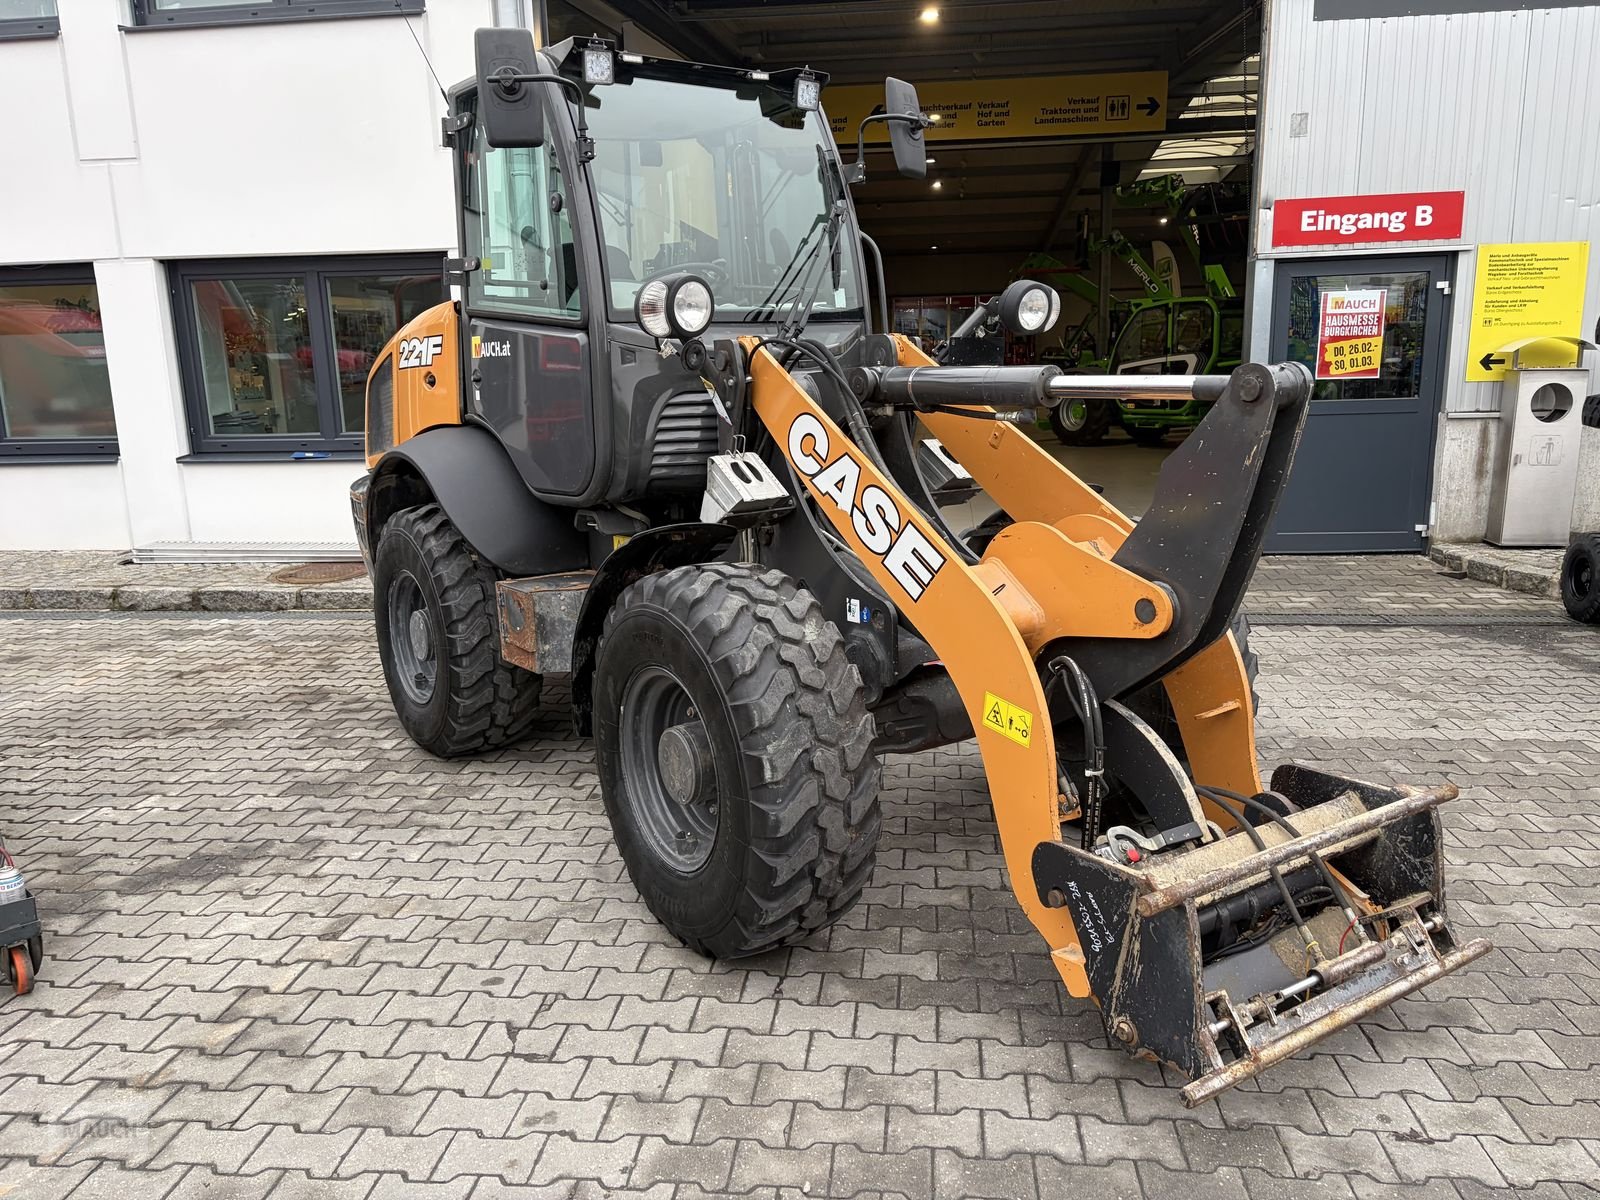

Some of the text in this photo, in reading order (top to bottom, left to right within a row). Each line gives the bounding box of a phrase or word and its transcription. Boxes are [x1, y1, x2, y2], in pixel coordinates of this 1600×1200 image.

[977, 100, 1010, 109] Verkauf
[1067, 96, 1100, 106] Verkauf
[977, 110, 1010, 118] Hof und
[1041, 105, 1100, 116] Traktoren und
[976, 119, 1006, 128] Garten
[1034, 115, 1100, 125] Landmaschinen
[1300, 205, 1434, 235] Eingang B
[1127, 258, 1160, 293] MERLO
[1333, 299, 1377, 310] MAUCH
[1325, 314, 1380, 326] HAUSMESSE
[1324, 325, 1378, 337] BURGKIRCHEN
[399, 334, 444, 370] 221F
[472, 338, 512, 358] MAUCH.at
[1333, 346, 1347, 358] DO,
[1334, 356, 1375, 371] SO, 01.03.
[788, 412, 948, 603] CASE
